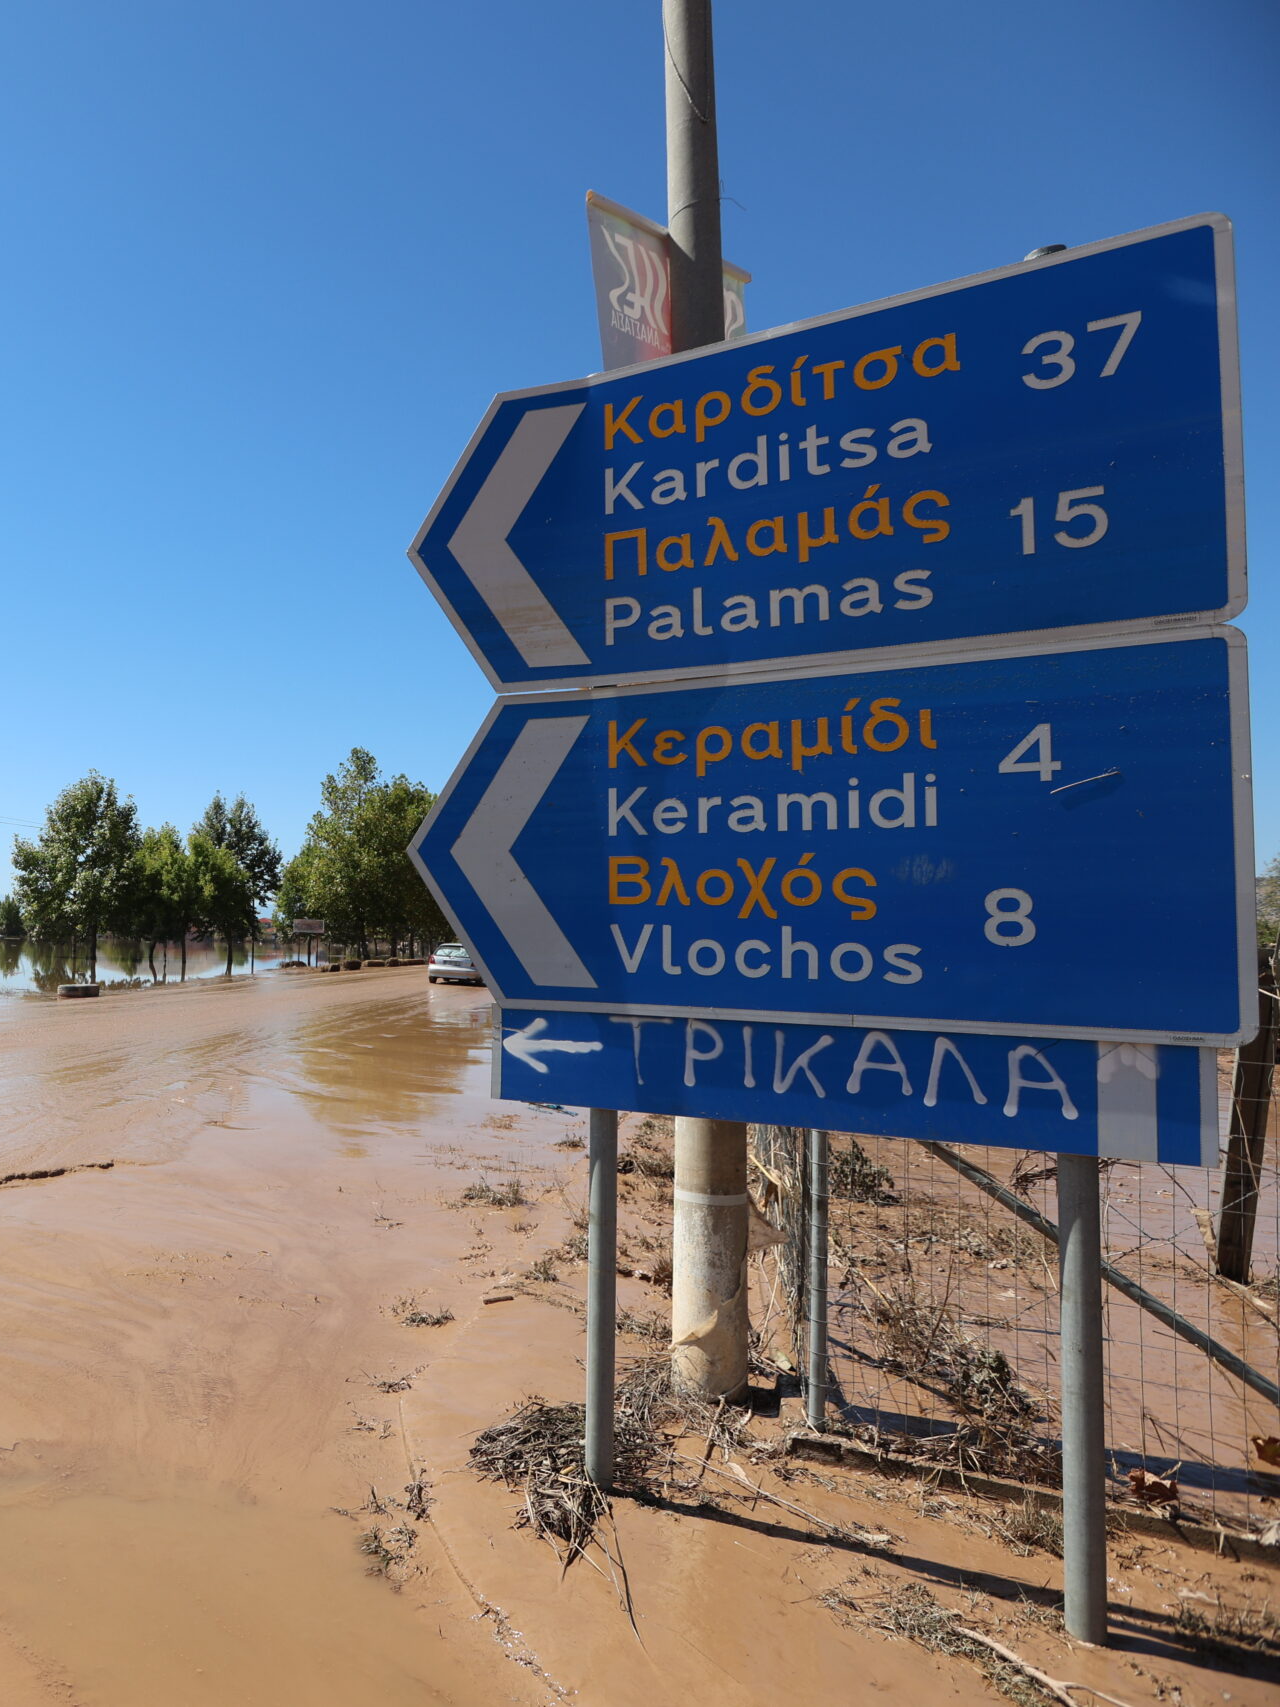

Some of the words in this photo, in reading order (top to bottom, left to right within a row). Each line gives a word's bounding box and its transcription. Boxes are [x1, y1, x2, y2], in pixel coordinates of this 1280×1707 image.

[1021, 310, 1143, 390] 37
[604, 333, 961, 450] Καρδίτσα
[605, 418, 933, 515] Karditsa
[605, 484, 950, 581] Παλαμάς
[1009, 485, 1110, 557] 15
[605, 569, 934, 647] Palamas
[607, 697, 938, 777] Κεραμίδι
[998, 723, 1062, 783] 4
[608, 773, 938, 836] Keramidi
[609, 853, 878, 921] Βλοχός
[984, 888, 1037, 948] 8
[610, 925, 924, 986] Vlochos
[608, 1016, 1079, 1121] ΤΡΙΚΑΛΑ
